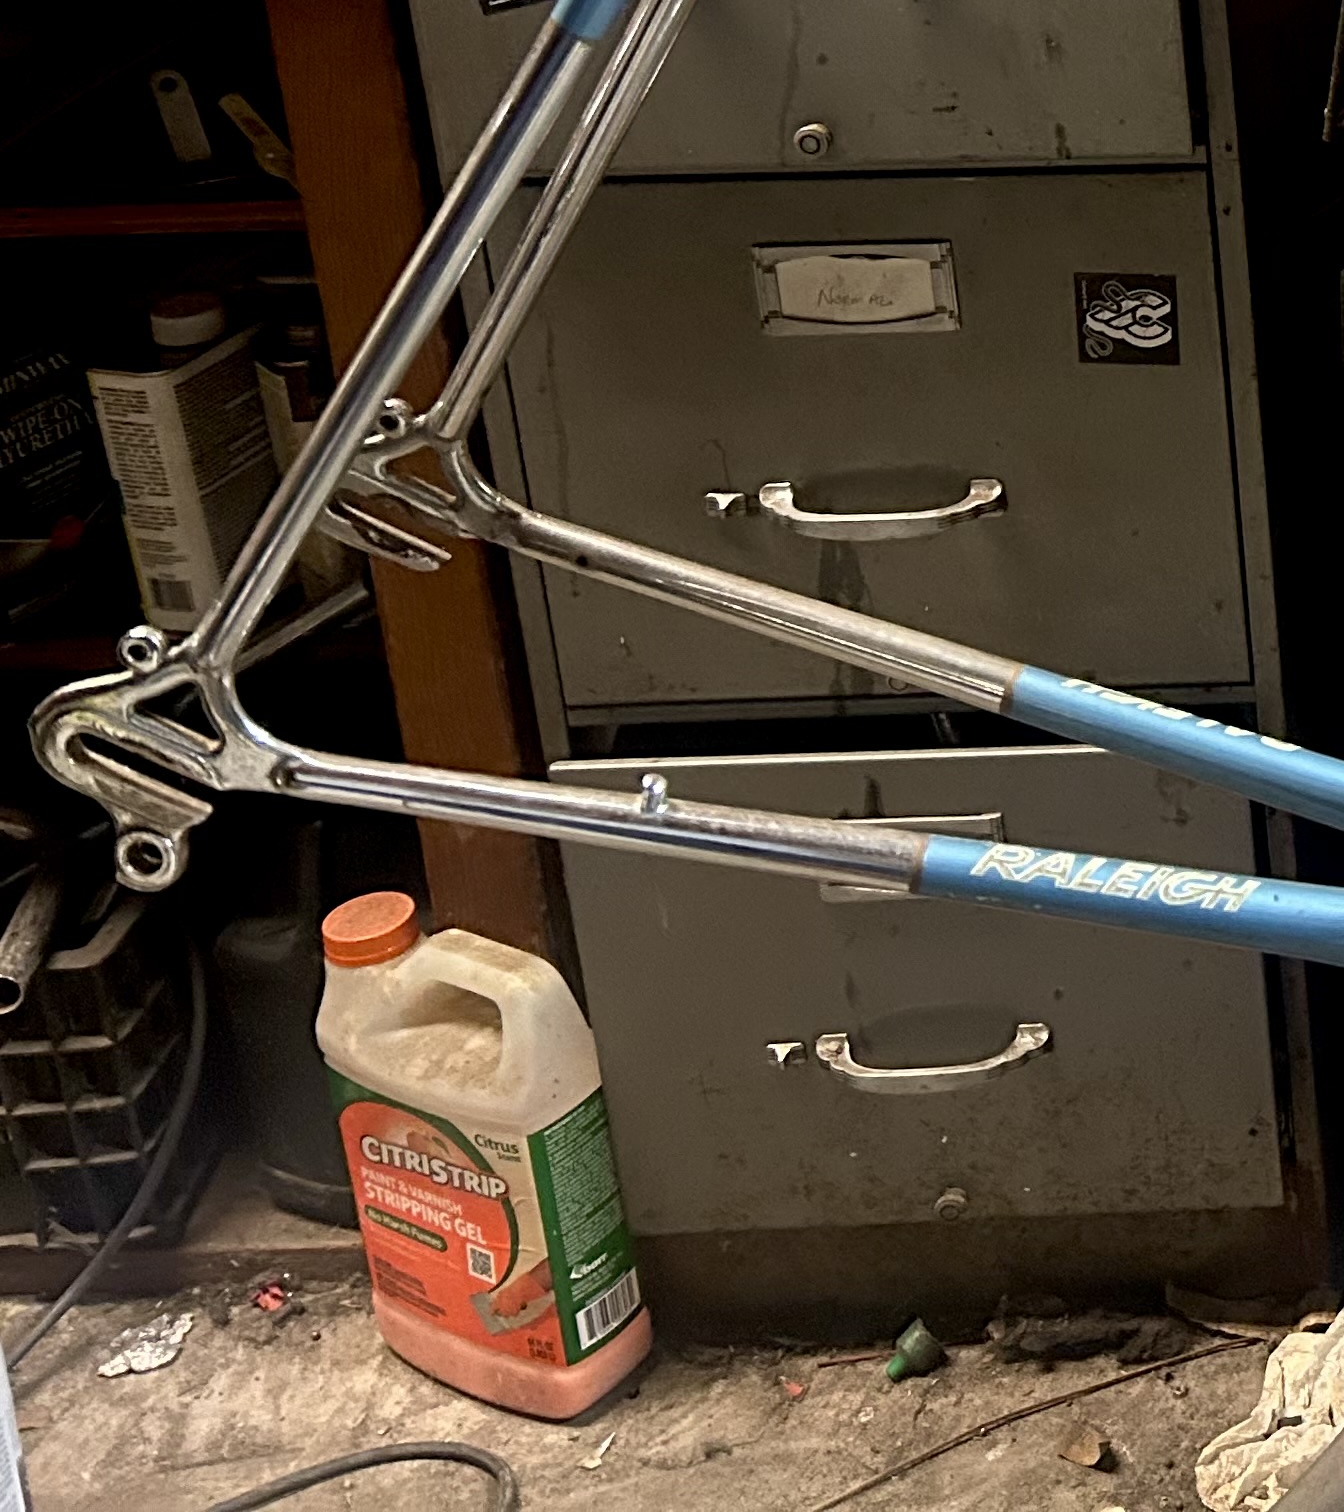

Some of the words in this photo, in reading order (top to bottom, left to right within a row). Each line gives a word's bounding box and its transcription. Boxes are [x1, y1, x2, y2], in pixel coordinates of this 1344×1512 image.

[970, 842, 1261, 913] RALEIGH
[361, 1135, 509, 1199] CITRISTRIP
[474, 1134, 520, 1155] Citrus
[361, 1167, 397, 1188] PAINT
[399, 1180, 408, 1193] &
[407, 1184, 463, 1216] VARNISH
[364, 1181, 452, 1231] STRIPPING
[454, 1218, 487, 1245] GEL
